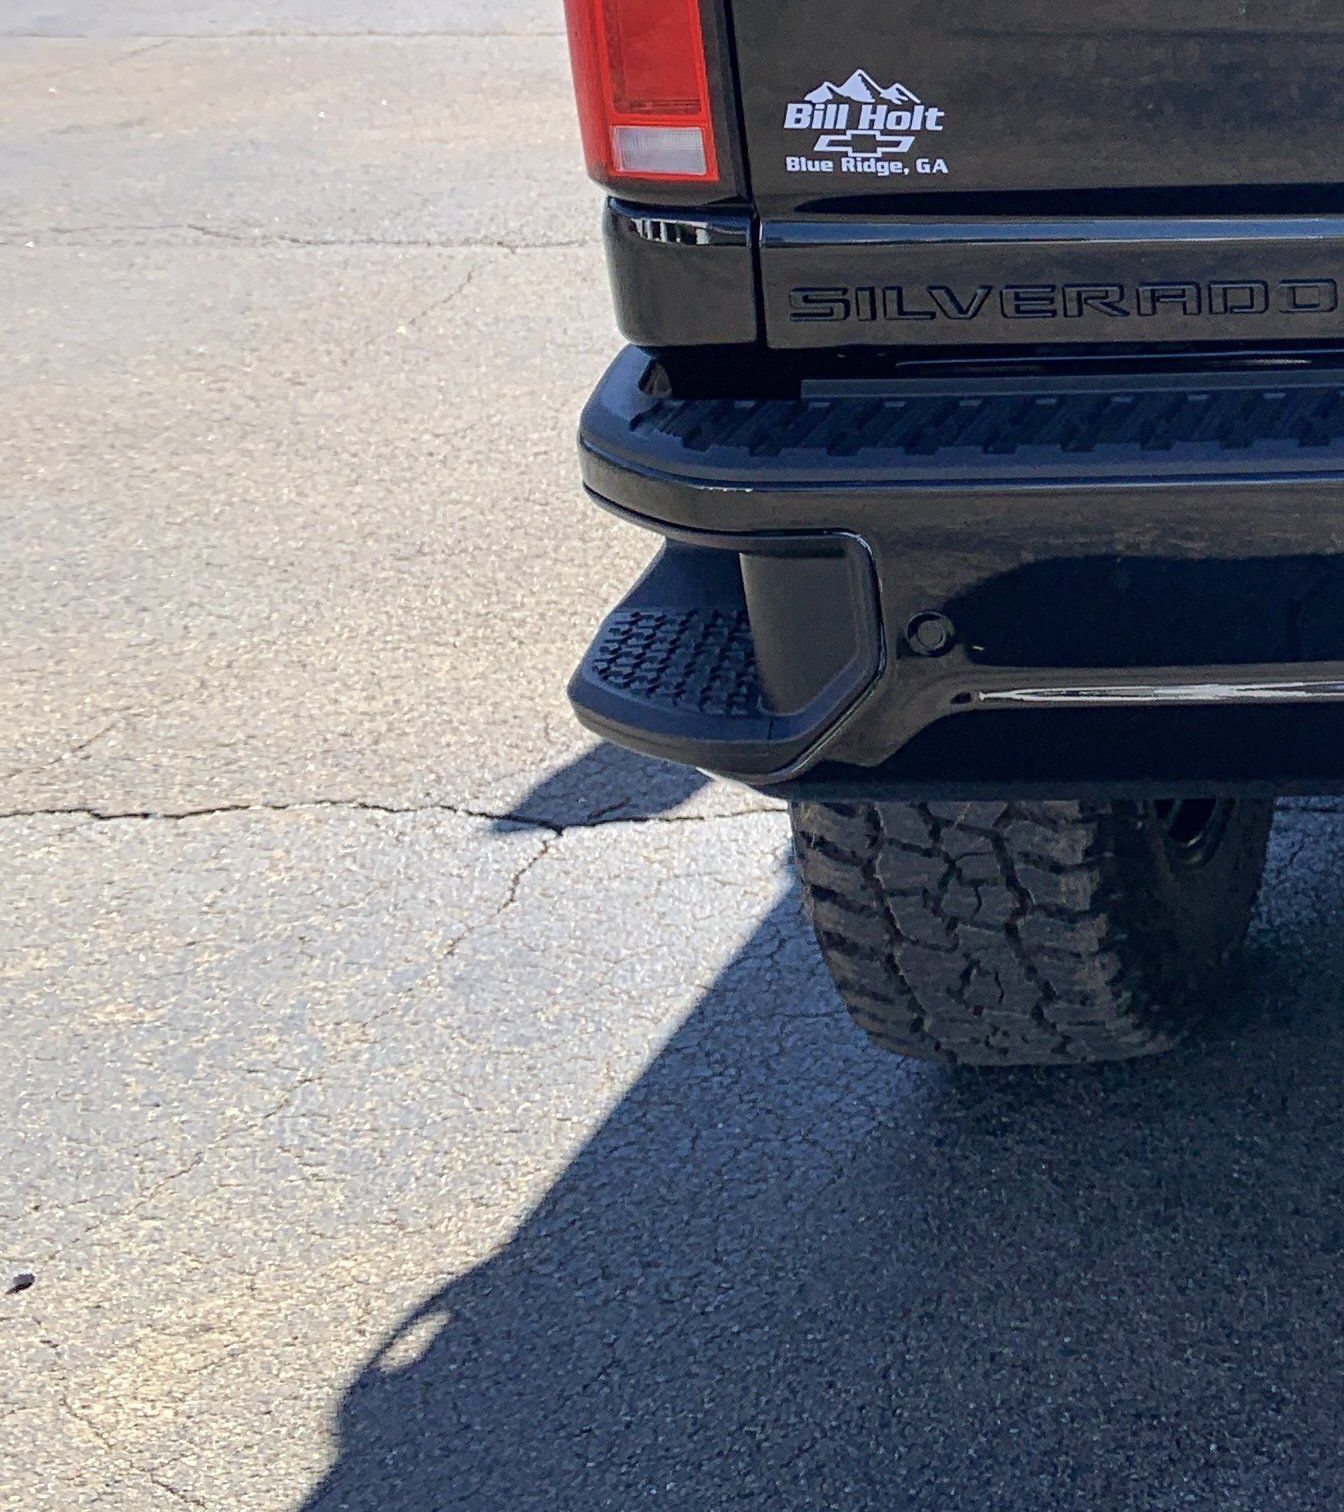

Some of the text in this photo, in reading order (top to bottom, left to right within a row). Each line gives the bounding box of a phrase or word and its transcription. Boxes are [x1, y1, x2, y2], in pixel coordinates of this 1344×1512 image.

[784, 103, 945, 131] Bill Holt
[785, 156, 949, 176] Blue Ridge, GA
[789, 278, 1339, 322] SILVERADO
